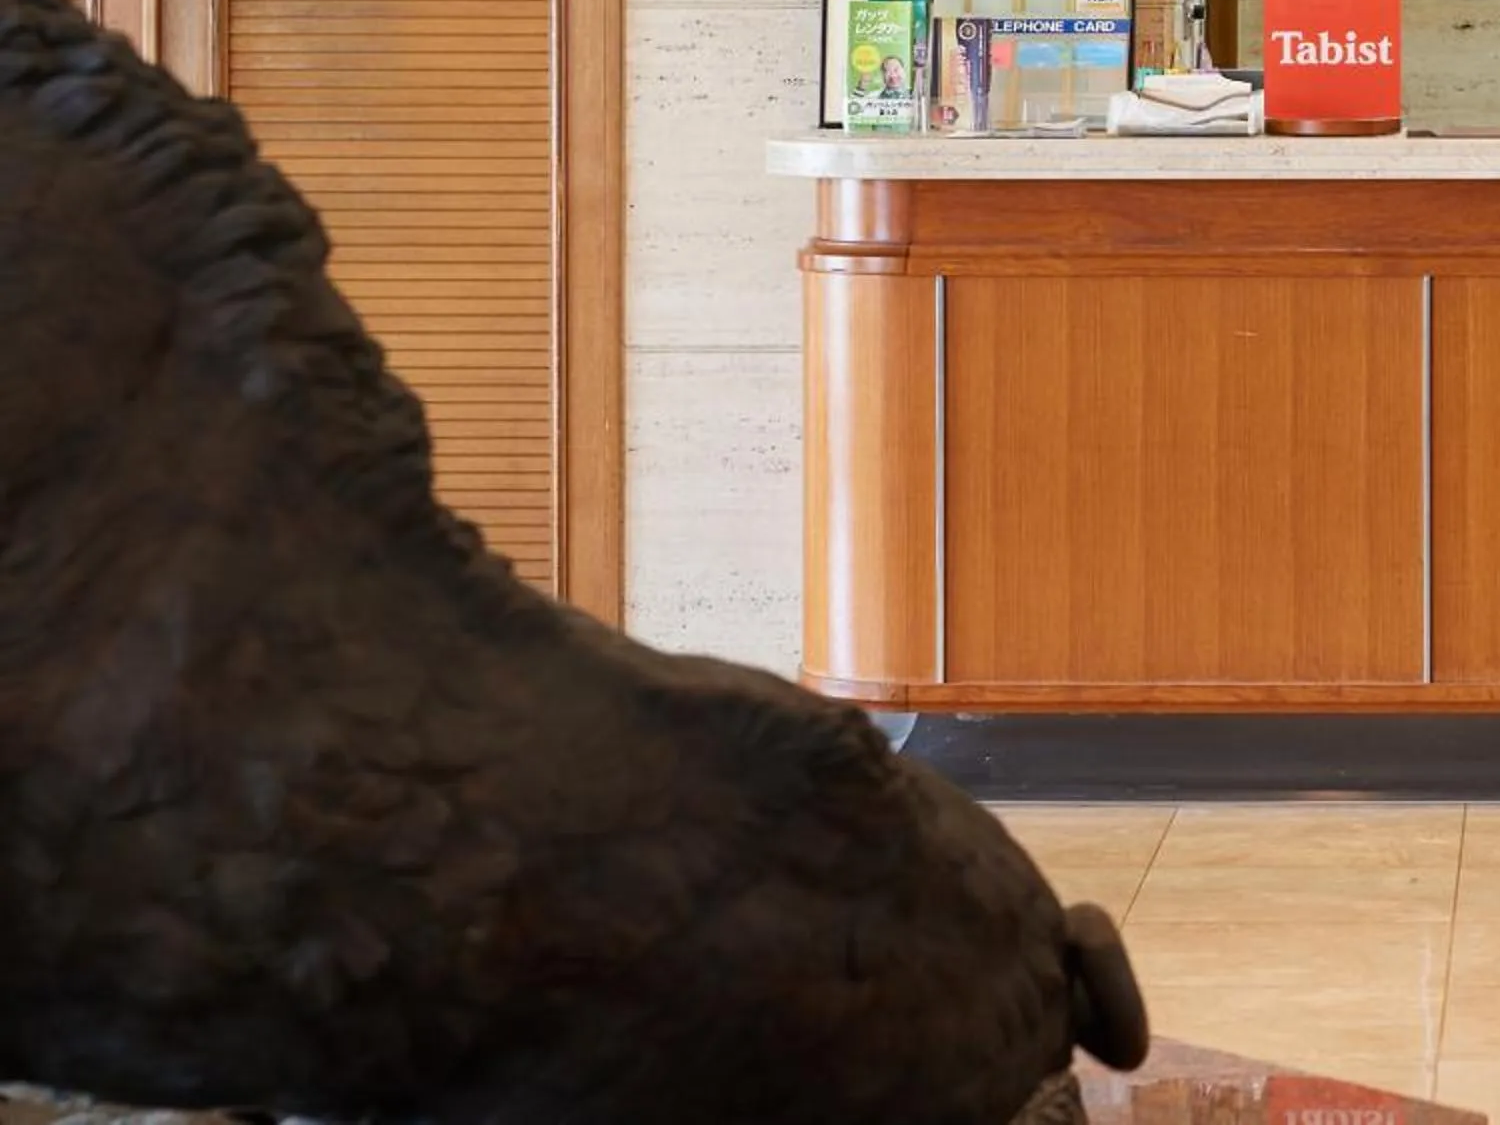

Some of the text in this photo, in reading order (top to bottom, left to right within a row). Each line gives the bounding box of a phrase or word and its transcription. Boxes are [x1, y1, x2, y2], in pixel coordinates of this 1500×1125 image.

[993, 19, 1116, 32] LEPHONE CARD
[1271, 30, 1395, 65] Tabist
